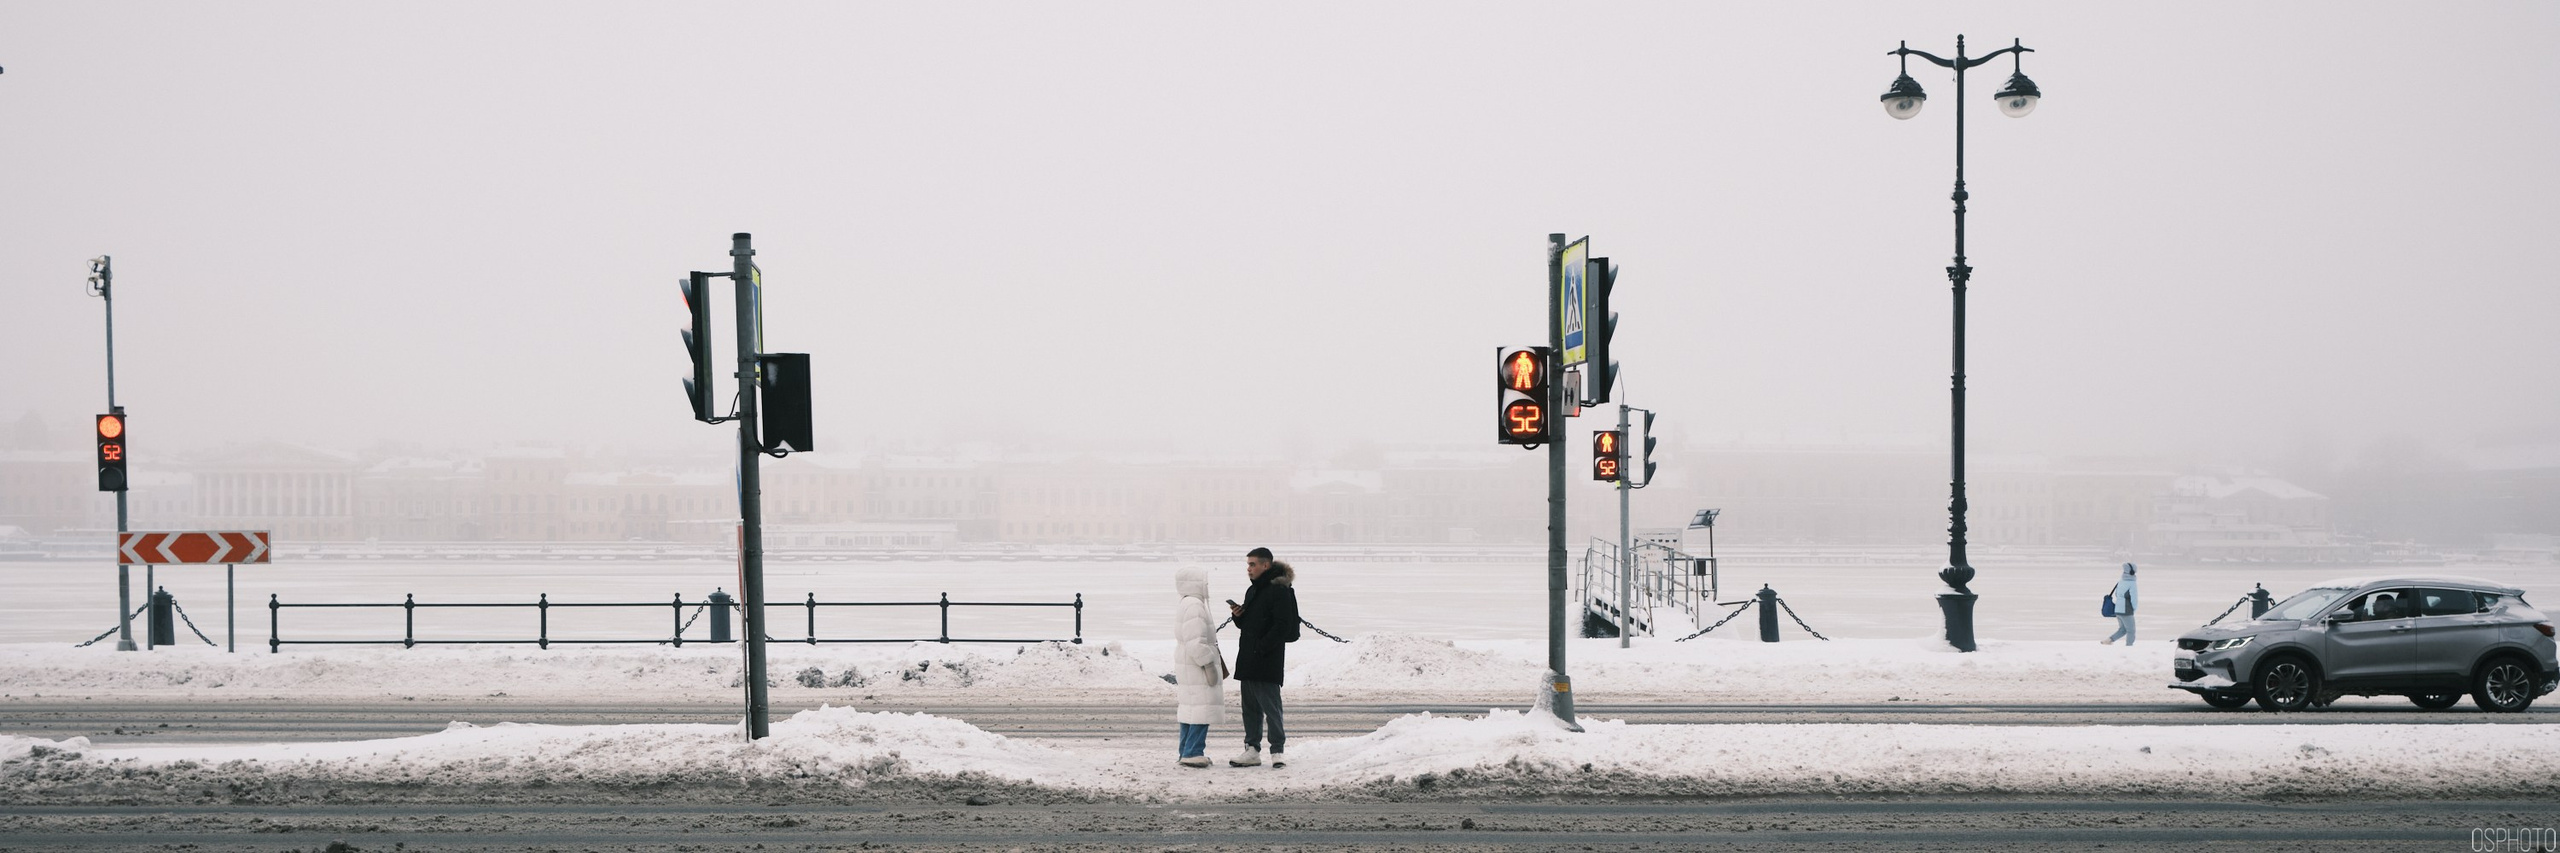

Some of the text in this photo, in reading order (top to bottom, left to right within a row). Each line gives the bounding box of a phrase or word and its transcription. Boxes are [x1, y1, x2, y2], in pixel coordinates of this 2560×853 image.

[1510, 405, 1539, 432] 52
[103, 444, 121, 460] 52
[1600, 460, 1615, 475] 52
